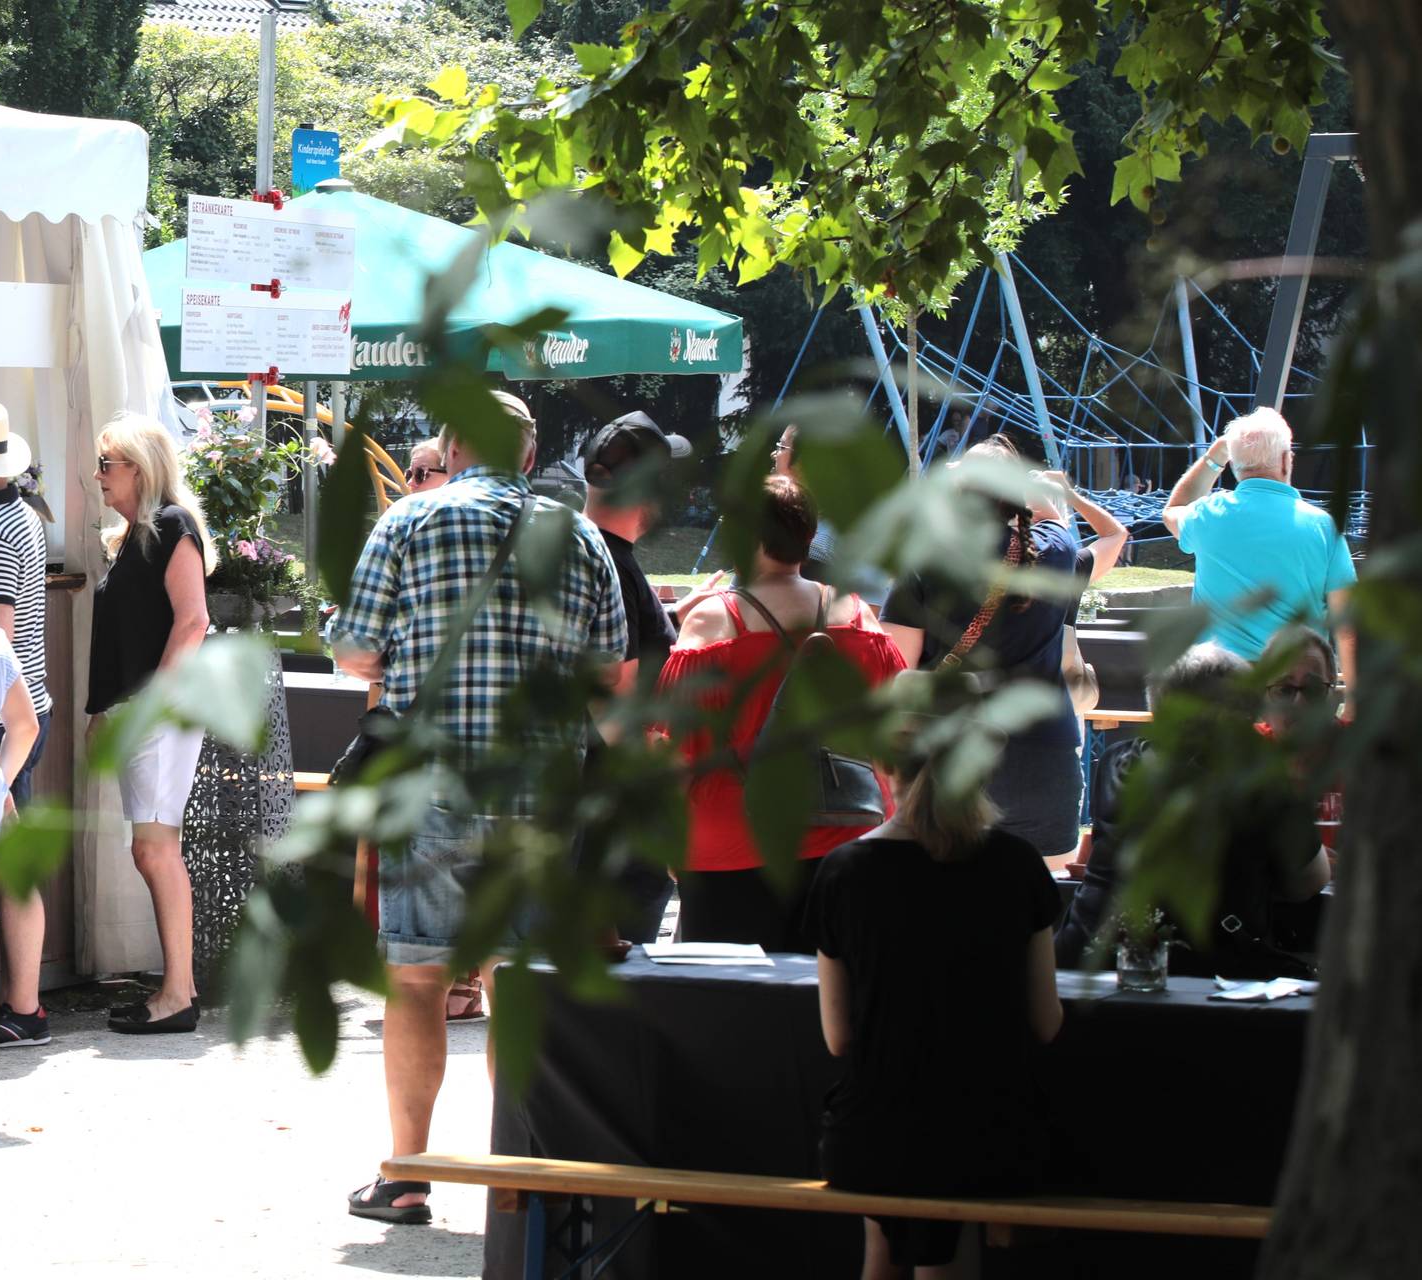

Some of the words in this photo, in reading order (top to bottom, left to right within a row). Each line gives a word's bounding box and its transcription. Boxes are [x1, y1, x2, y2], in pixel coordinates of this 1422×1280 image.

[191, 201, 233, 217] GETRÄNKEKARTE
[186, 293, 221, 306] SPEISEKARTE
[350, 332, 426, 370] tauder
[541, 330, 589, 369] Stauder
[683, 328, 719, 365] Stauder
